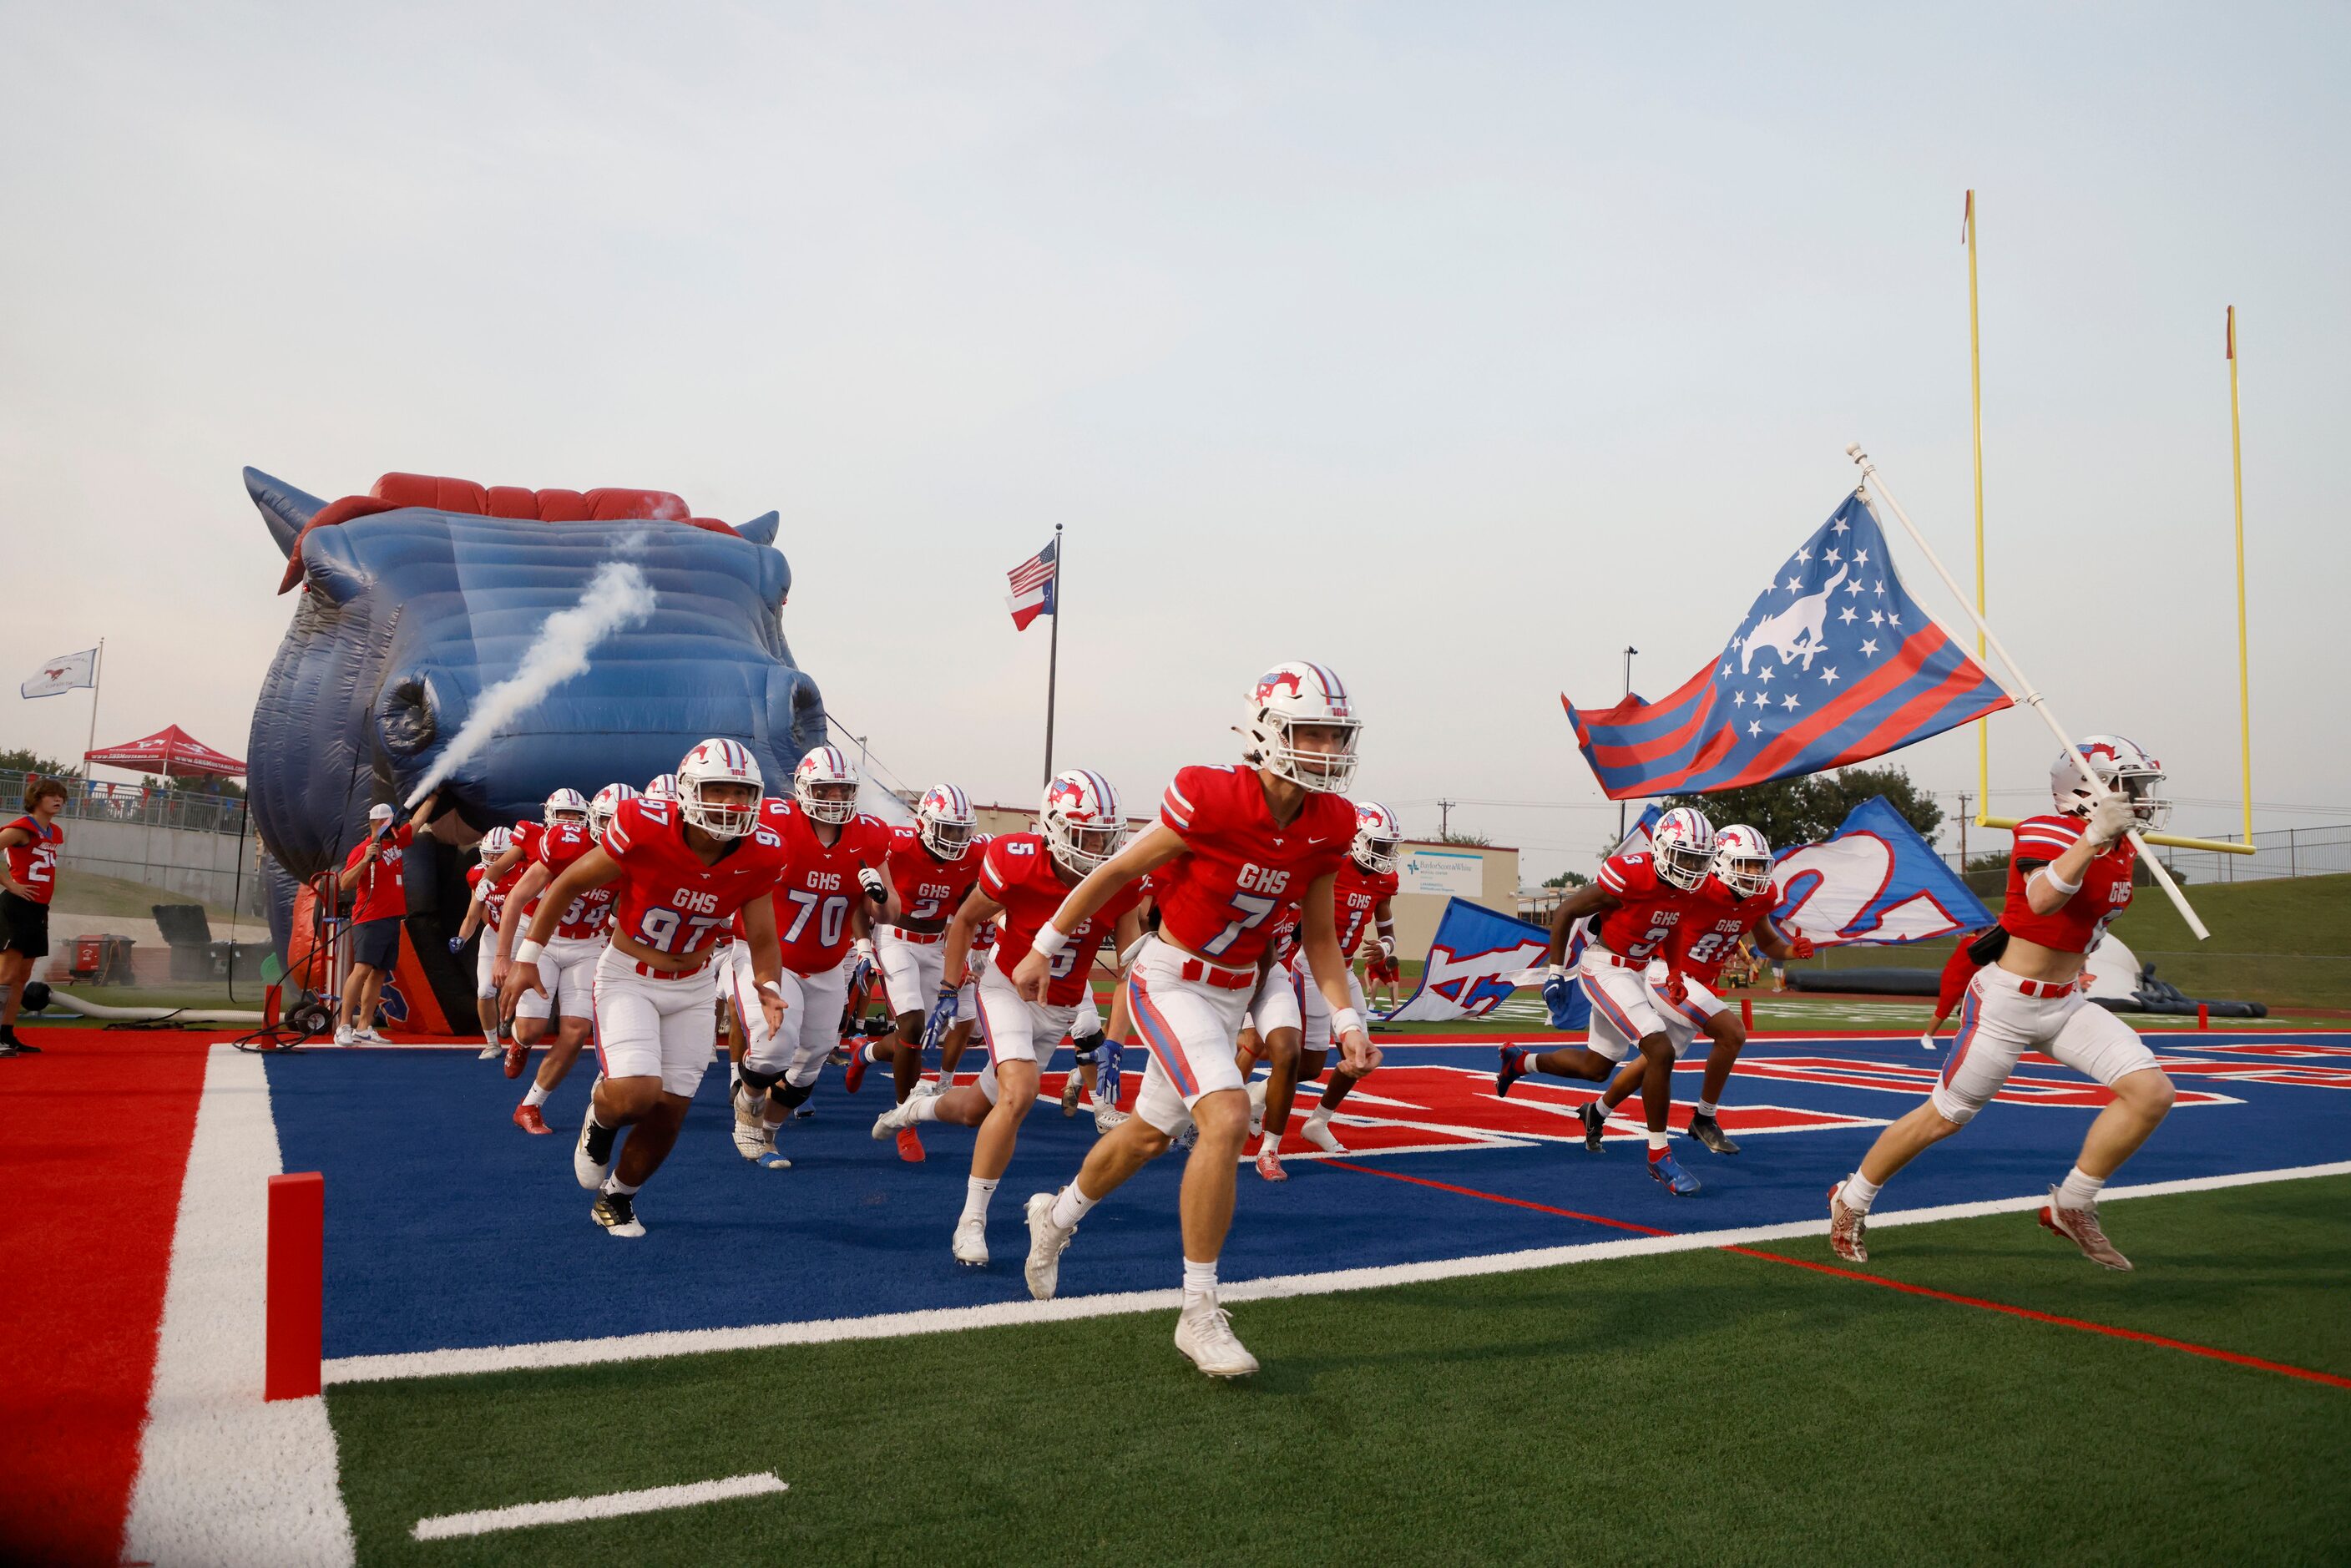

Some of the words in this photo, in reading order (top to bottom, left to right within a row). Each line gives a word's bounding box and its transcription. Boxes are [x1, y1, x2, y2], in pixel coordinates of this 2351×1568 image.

[1332, 707, 1348, 717] 104
[731, 768, 746, 776] 104
[637, 798, 668, 827] 97
[1103, 817, 1116, 825] 104
[561, 823, 581, 843] 34
[895, 829, 914, 838] 2
[1007, 842, 1035, 856] 5
[1622, 855, 1644, 865] 3
[806, 870, 842, 891] GHS
[1236, 862, 1291, 894] GHS
[918, 883, 951, 898] GHS
[2108, 881, 2132, 903] GHS
[672, 888, 719, 914] GHS
[910, 899, 940, 919] 2
[1347, 893, 1372, 909] GHS
[561, 897, 611, 929] 34
[781, 888, 850, 948] 70
[1651, 910, 1681, 926] GHS
[634, 906, 722, 953] 97
[1199, 890, 1280, 959] 7
[1281, 922, 1294, 933] HS
[1715, 919, 1742, 933] GHS
[1627, 928, 1670, 959] 3
